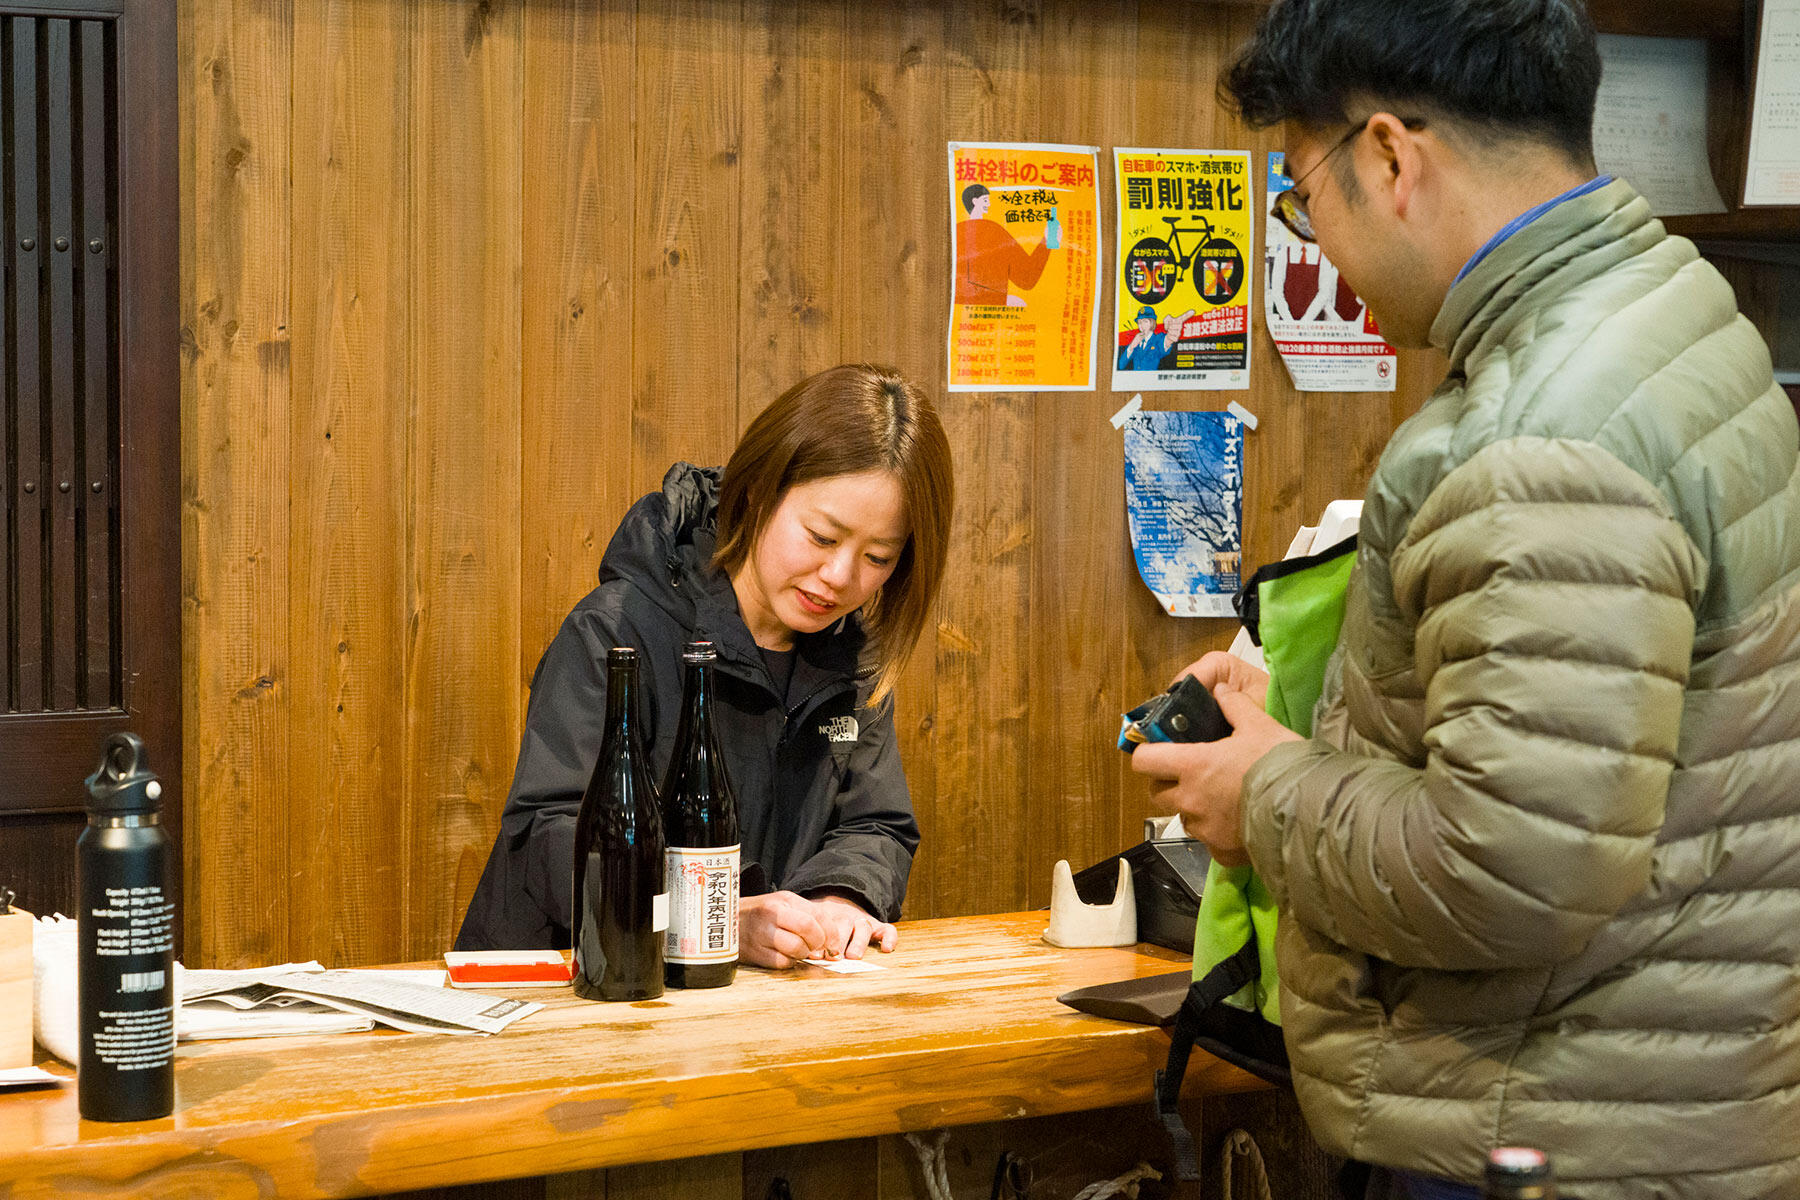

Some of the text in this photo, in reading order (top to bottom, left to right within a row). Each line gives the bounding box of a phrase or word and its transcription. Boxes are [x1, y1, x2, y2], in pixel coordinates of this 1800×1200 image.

[956, 158, 1094, 187] 抜栓料のご案内
[1123, 159, 1243, 174] 自転車のスマホ・酒気帯び
[1127, 177, 1243, 211] 罰則強化
[1133, 249, 1170, 257] ながらスマホ
[1183, 317, 1243, 337] 道路交通法改正
[1277, 343, 1389, 355] 月は20歳未満飲酒防止強調月間です。
[829, 716, 849, 726] THE
[818, 724, 848, 734] NORTH
[705, 857, 730, 867] 日本酒
[707, 871, 728, 949] 令和八年丙午二月四日
